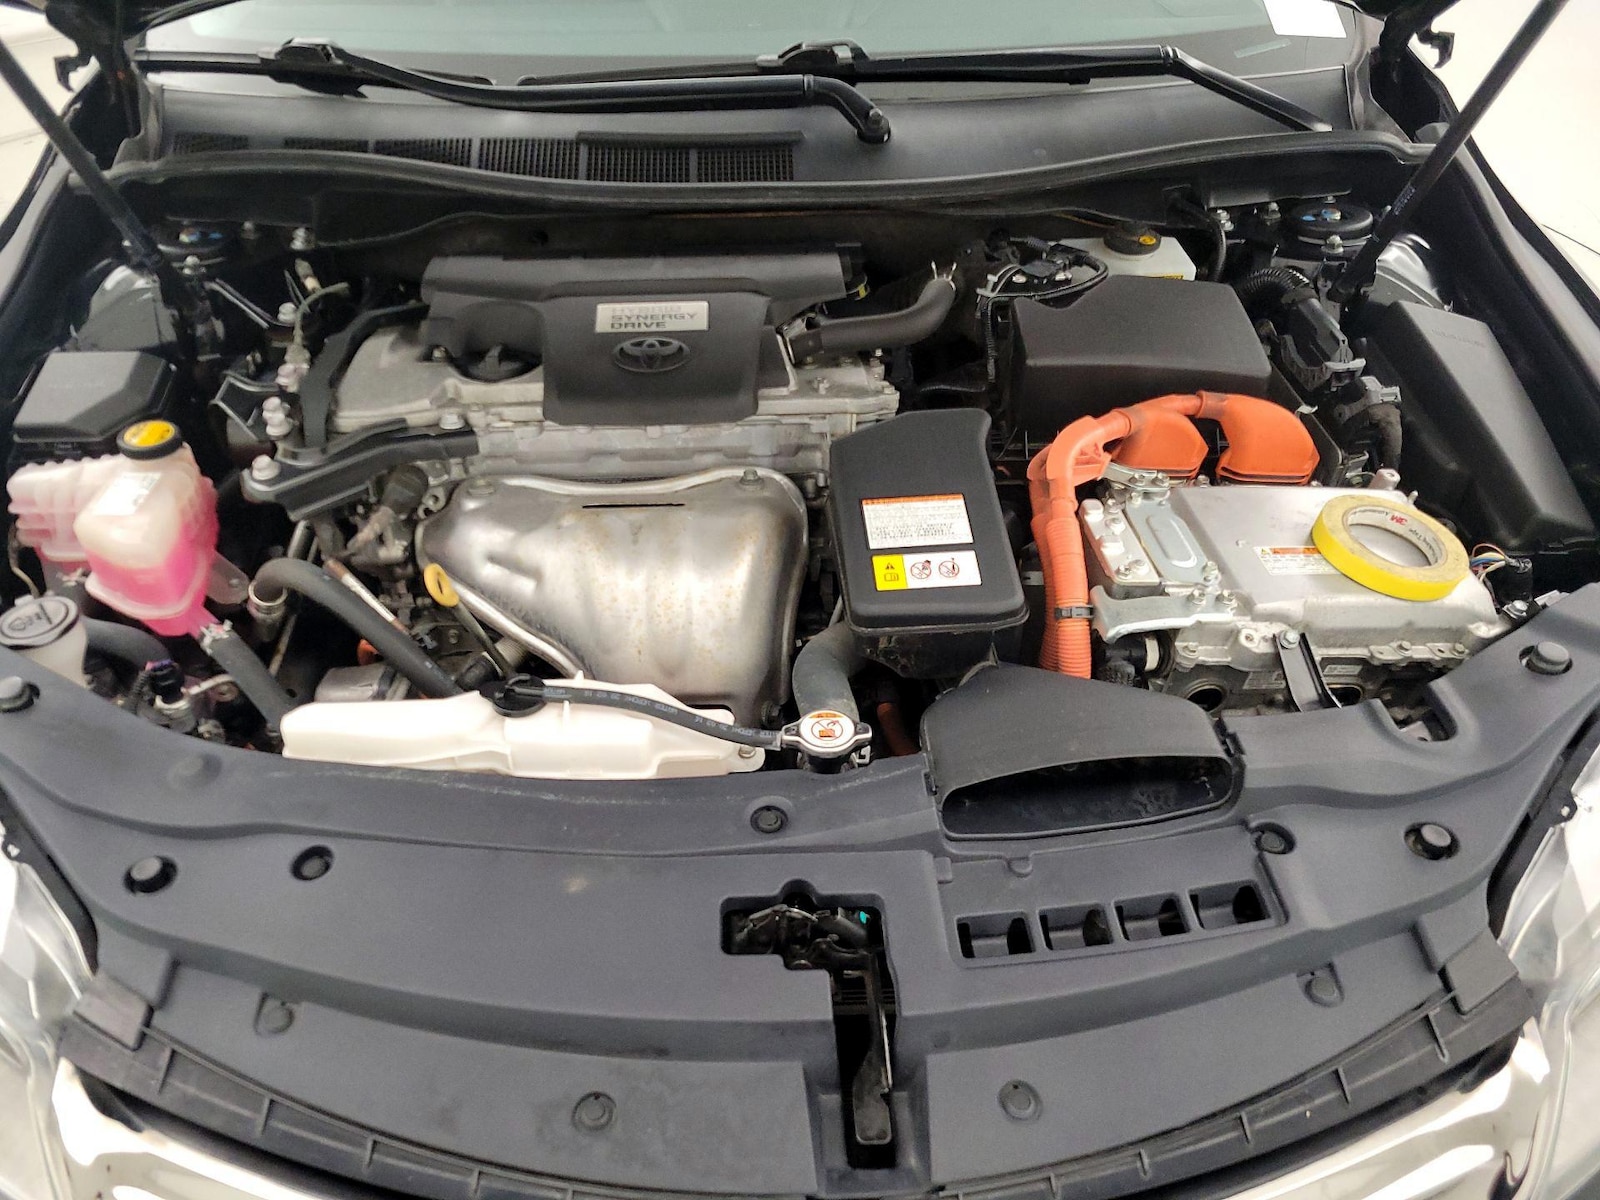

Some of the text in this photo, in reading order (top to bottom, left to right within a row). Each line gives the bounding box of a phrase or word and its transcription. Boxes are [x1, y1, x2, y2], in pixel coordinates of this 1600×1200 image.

[611, 313, 697, 321] SYNERGY
[610, 321, 667, 329] DRIVE
[1390, 514, 1408, 526] 3M
